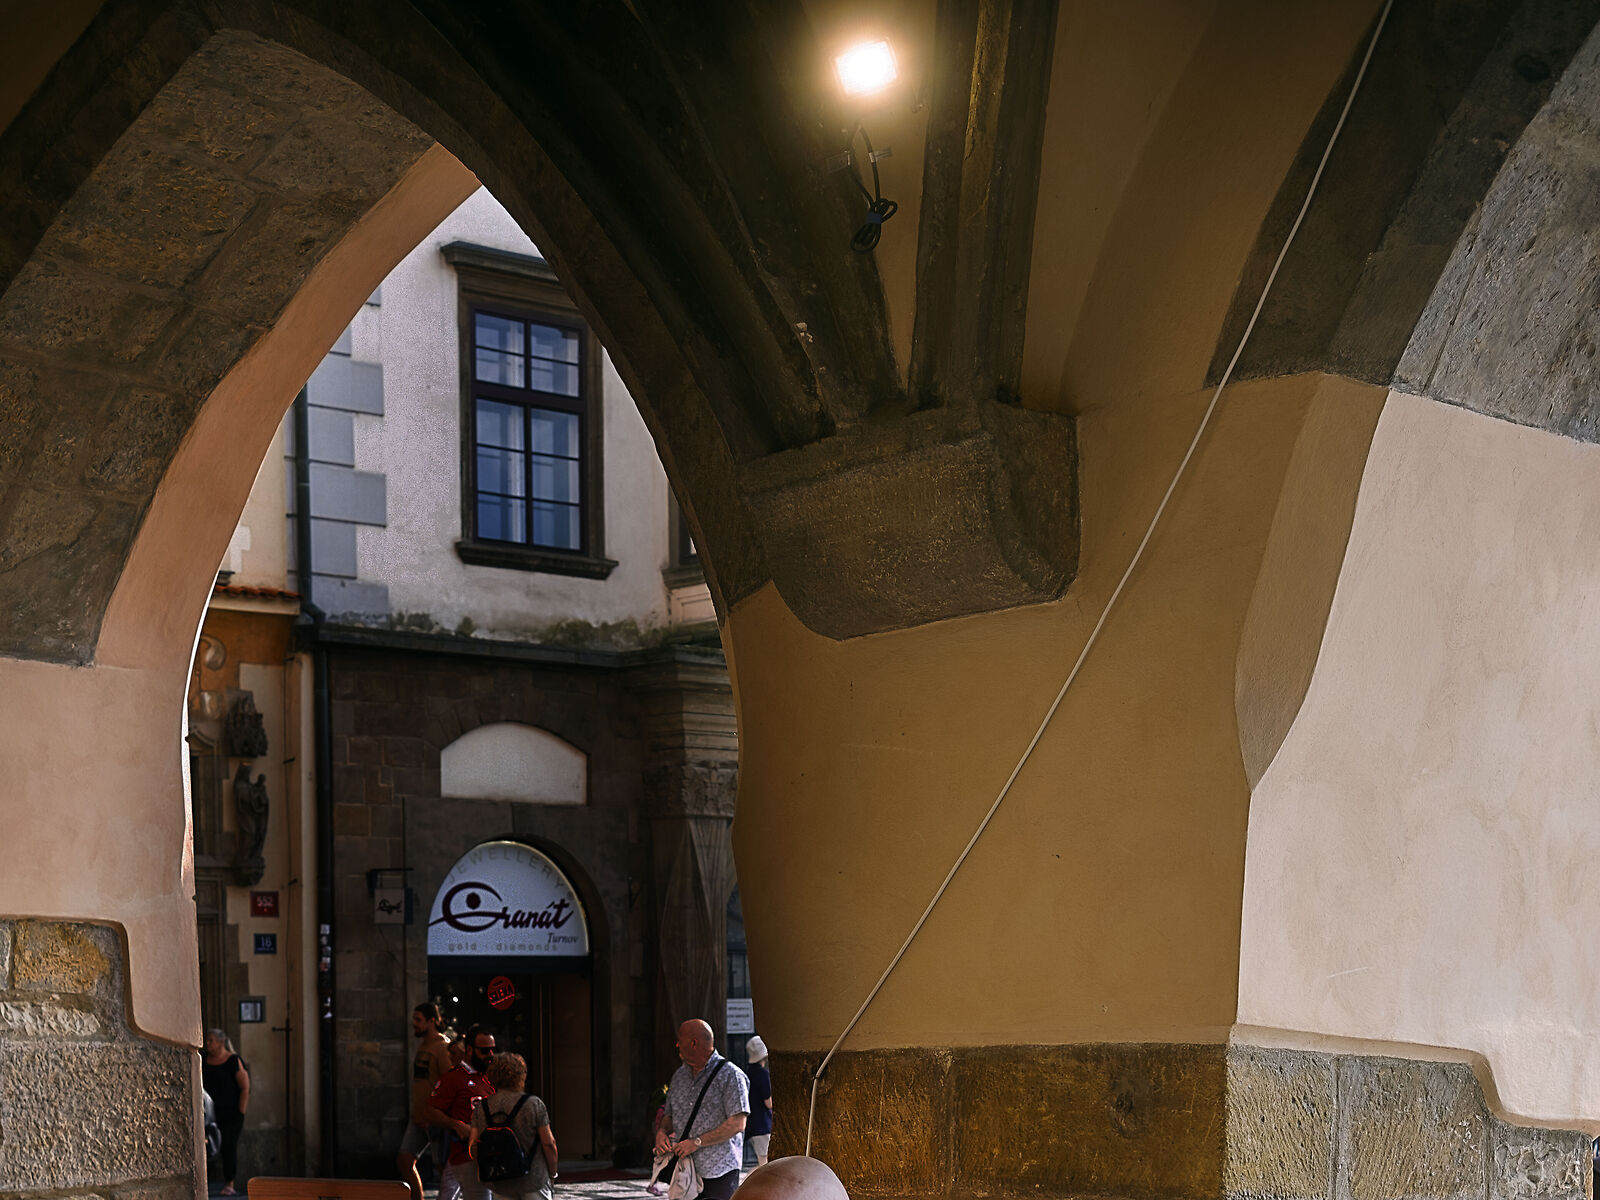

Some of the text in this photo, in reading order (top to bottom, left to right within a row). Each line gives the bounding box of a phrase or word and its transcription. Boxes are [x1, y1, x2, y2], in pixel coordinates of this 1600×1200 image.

[448, 847, 564, 888] JEWELLERY
[428, 882, 574, 933] Granát
[448, 942, 558, 952] gold diamonds
[547, 932, 579, 945] Turnov
